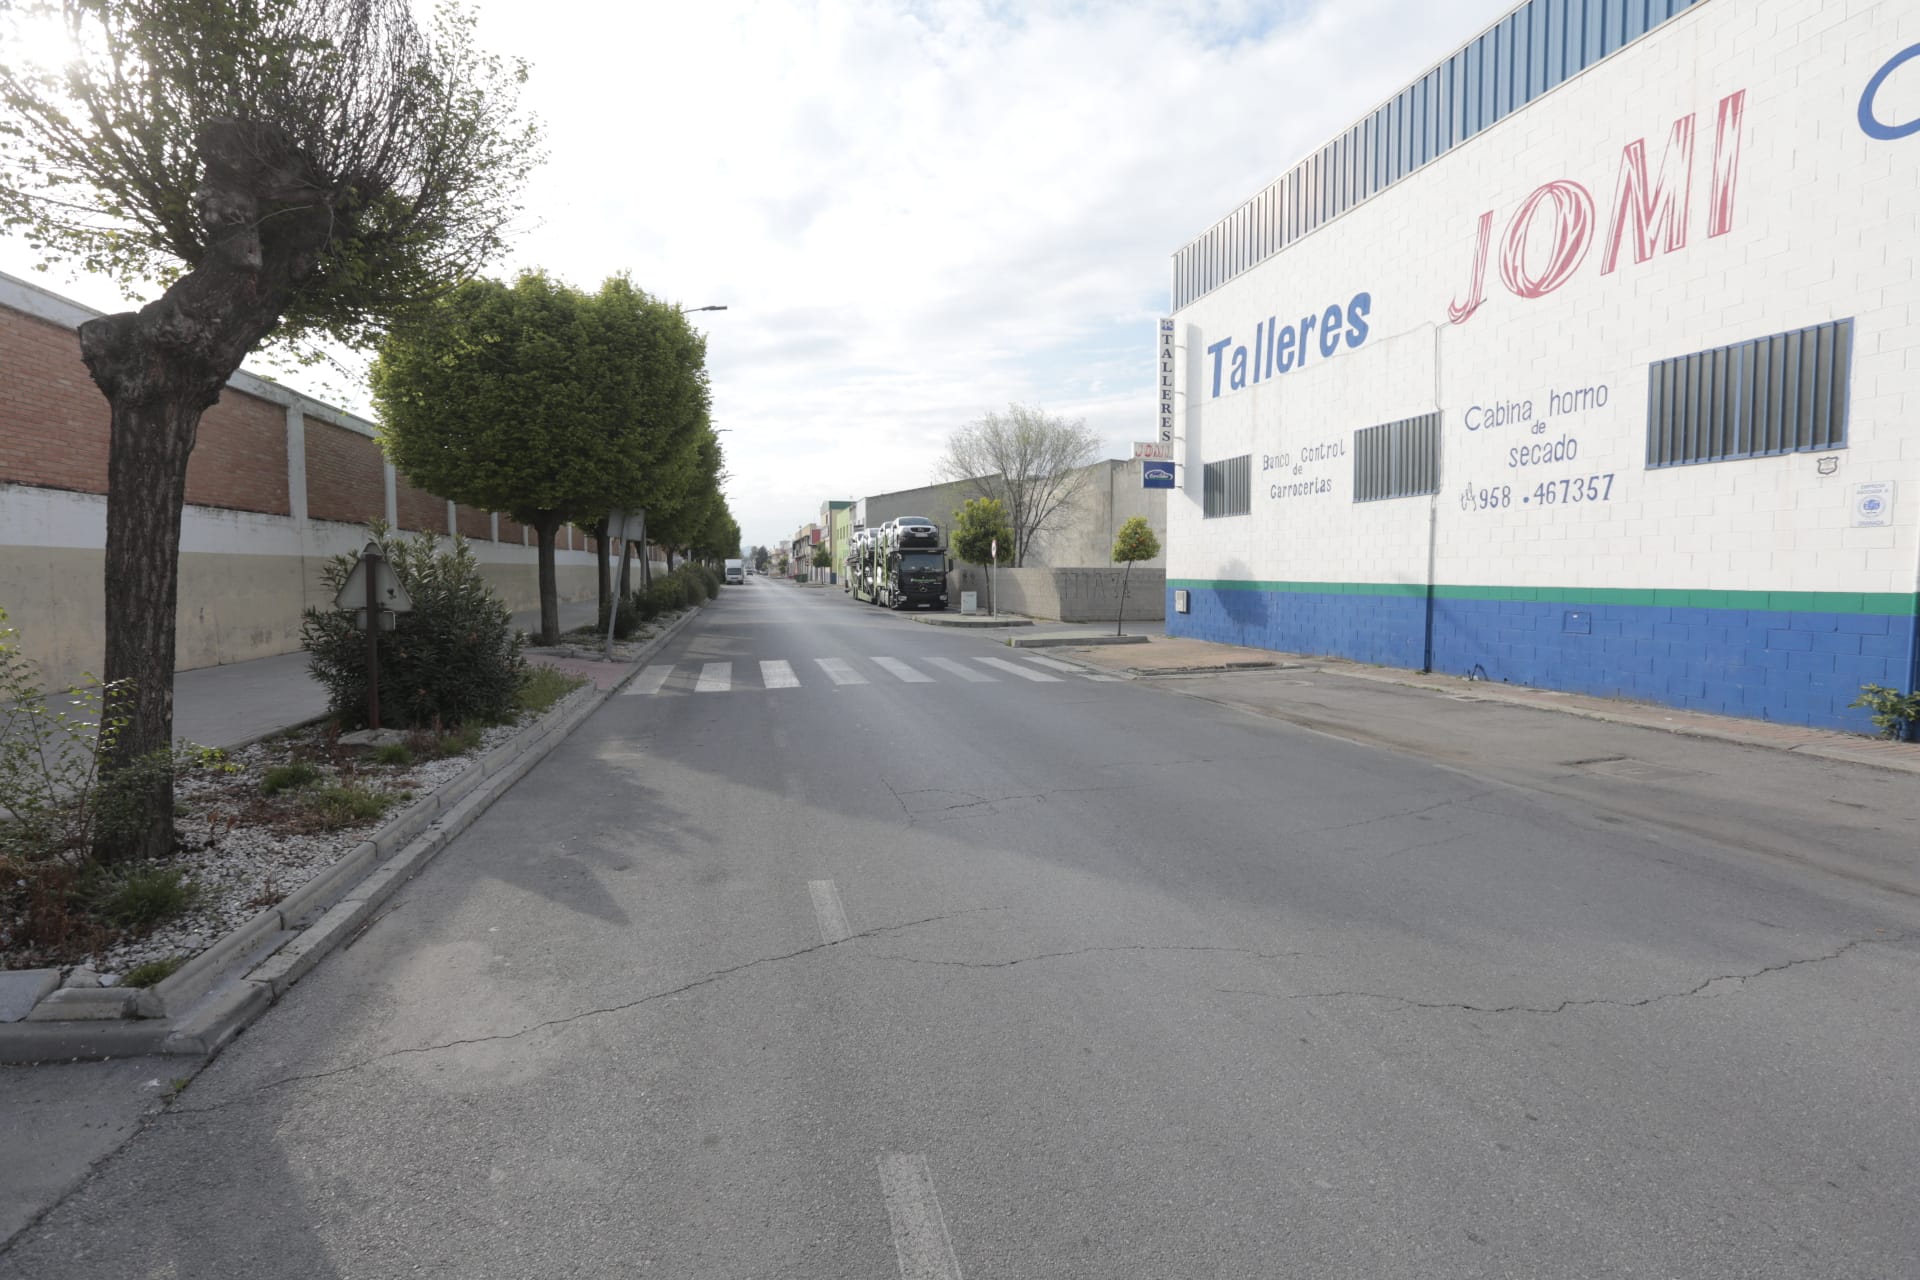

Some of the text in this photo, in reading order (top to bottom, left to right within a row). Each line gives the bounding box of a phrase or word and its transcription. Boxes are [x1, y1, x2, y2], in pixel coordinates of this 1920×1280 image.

[1207, 291, 1372, 398] Talleres
[1447, 88, 1746, 325] JOMI
[1161, 334, 1173, 442] TALLERES
[1464, 384, 1608, 435] Cabina de horno
[1263, 438, 1345, 475] Banco de Control
[1508, 433, 1578, 468] secado
[1479, 485, 1511, 509] 958
